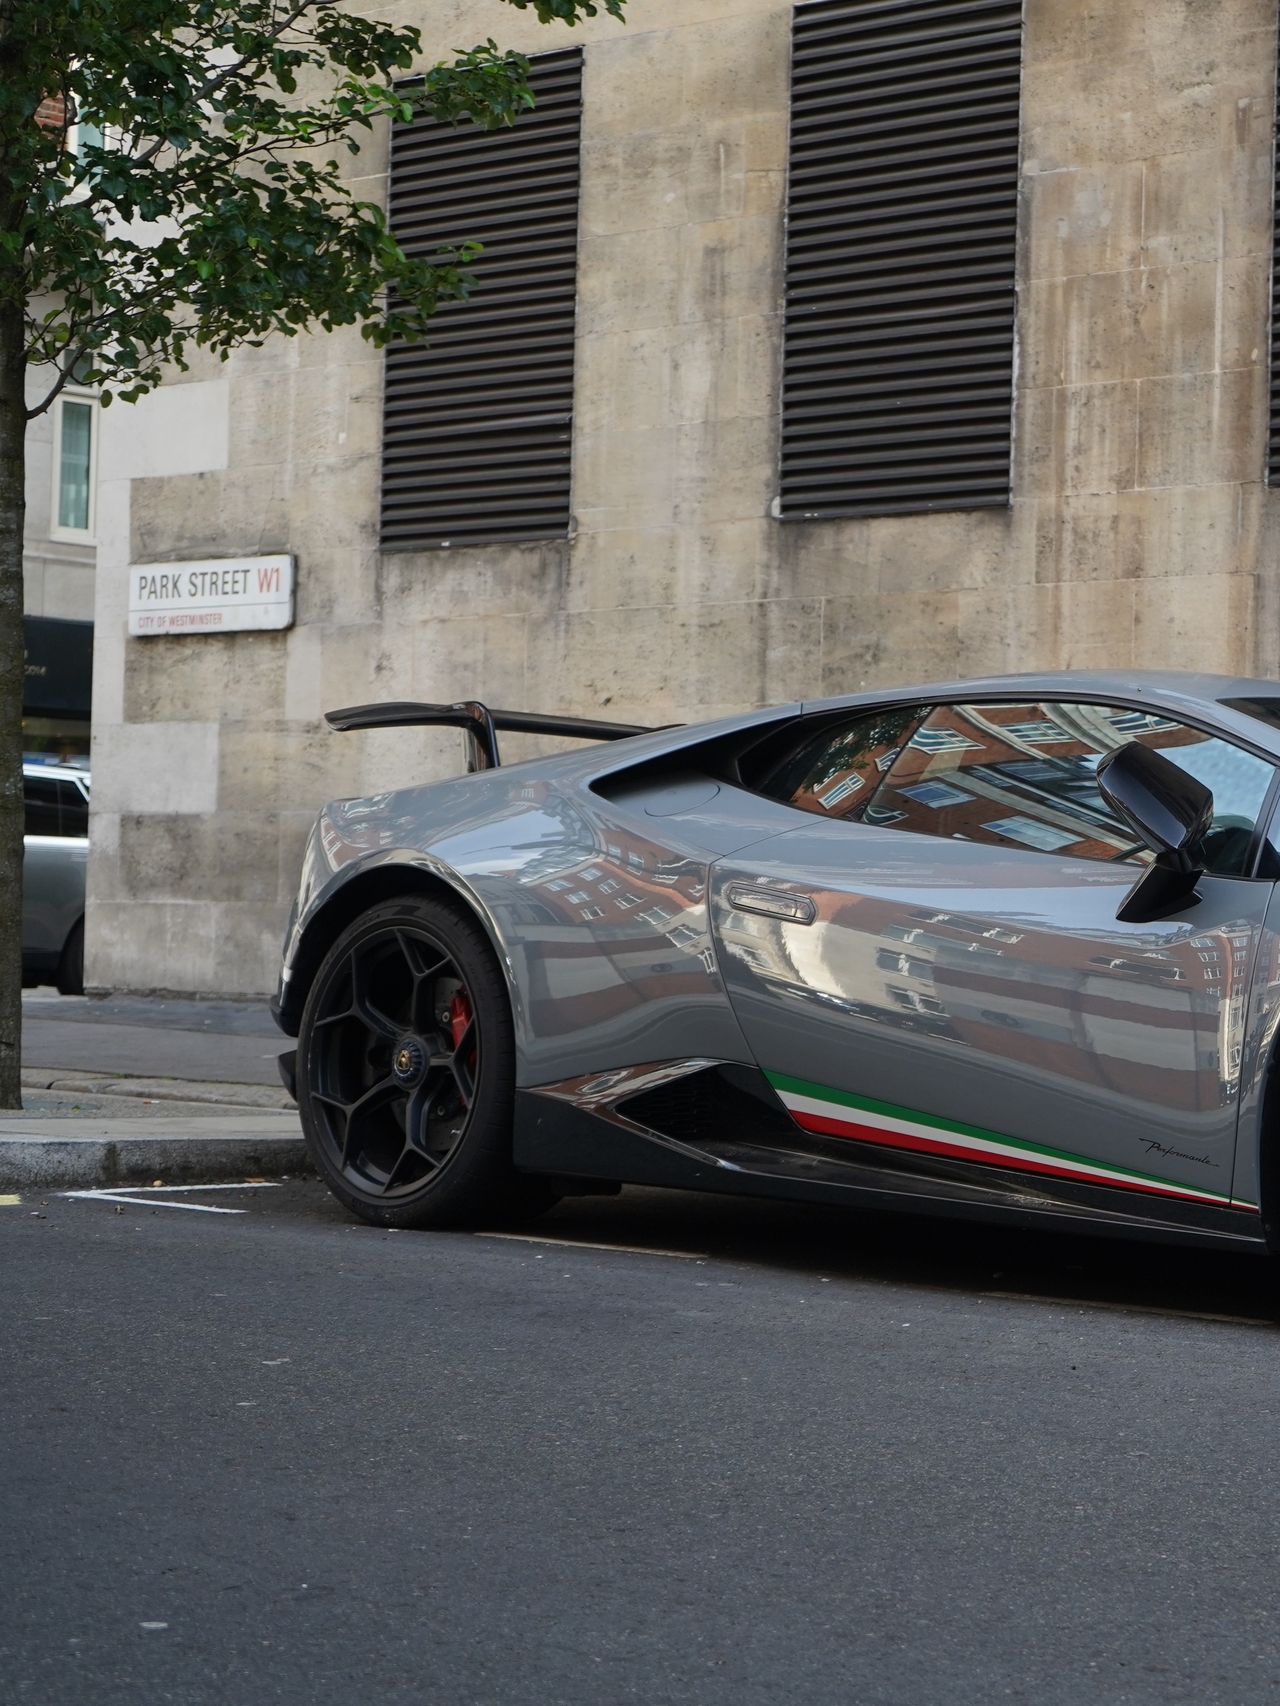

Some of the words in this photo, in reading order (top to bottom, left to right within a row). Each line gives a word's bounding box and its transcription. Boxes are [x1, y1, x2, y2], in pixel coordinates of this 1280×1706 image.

[139, 573, 182, 600] PARK
[188, 569, 251, 597] STREET
[257, 567, 280, 593] W1
[138, 616, 154, 629] CITY
[157, 615, 167, 628] OF
[168, 612, 223, 627] WESTMINSTER
[1138, 1137, 1220, 1167] Performante
